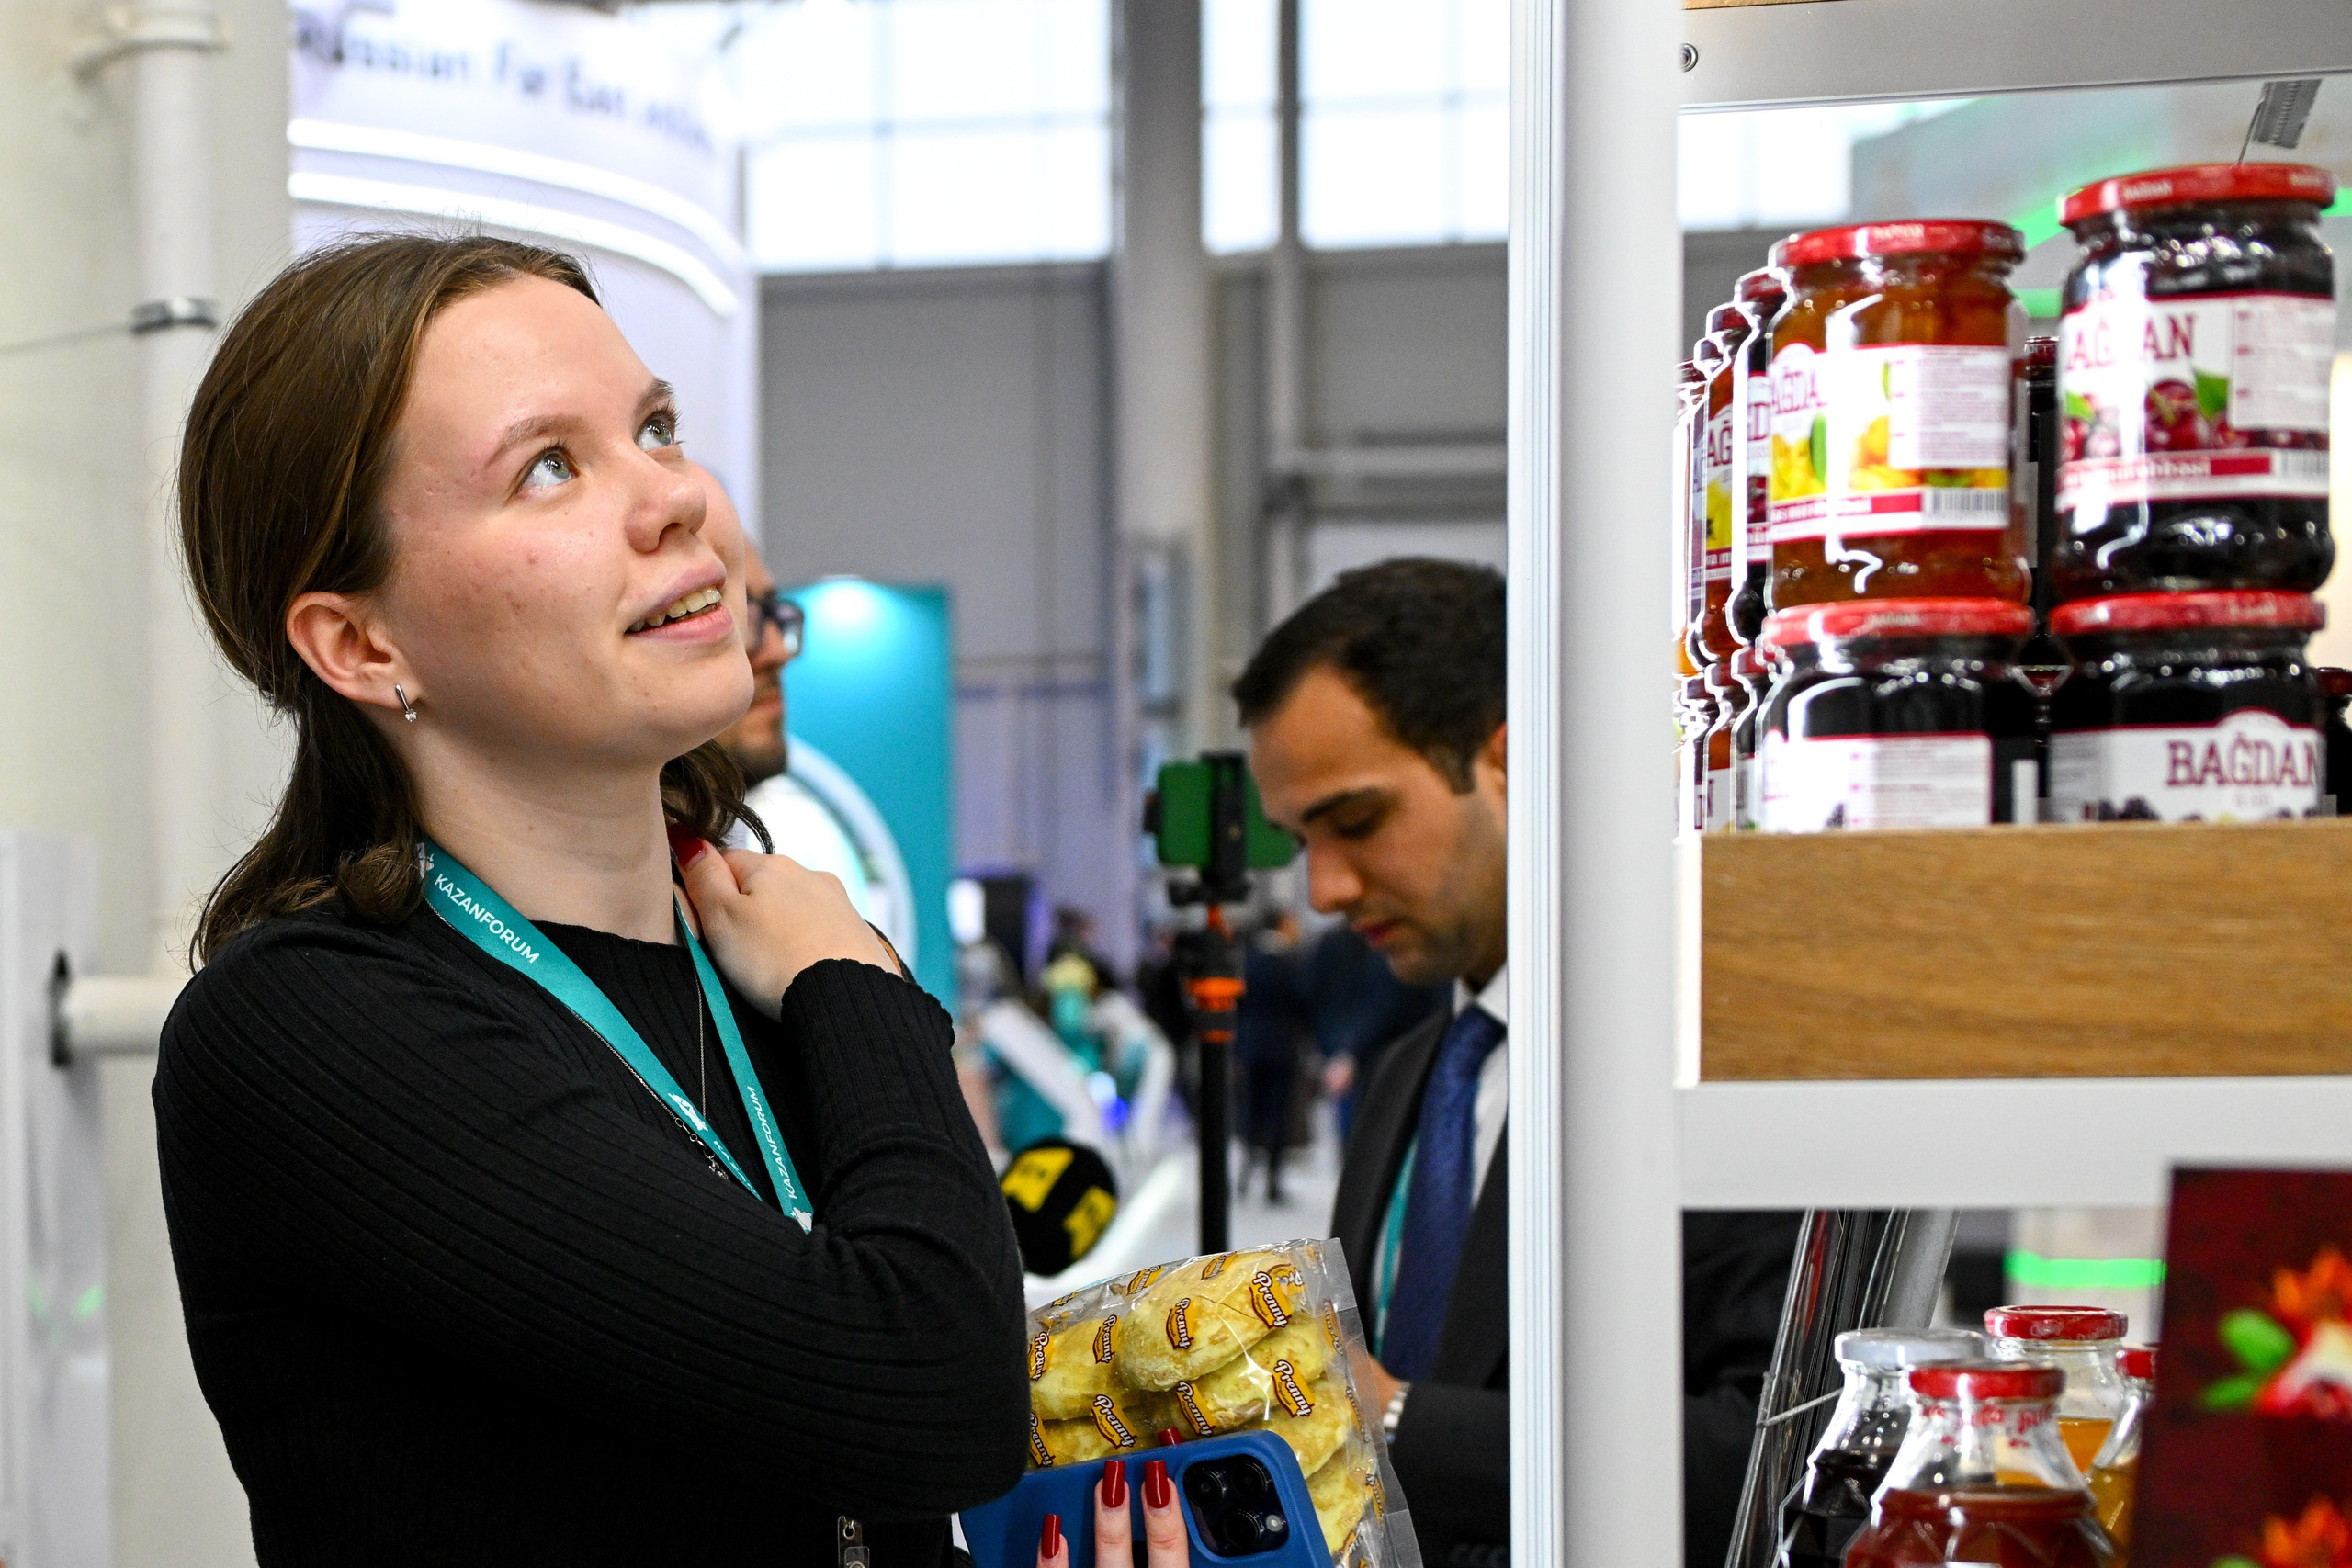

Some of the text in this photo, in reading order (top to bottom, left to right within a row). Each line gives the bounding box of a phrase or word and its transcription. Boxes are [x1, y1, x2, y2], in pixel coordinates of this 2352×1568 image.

[434, 873, 540, 964] KAZANFORUM
[746, 1085, 798, 1200] KAZANFORUM
[1175, 1297, 1192, 1349] Prenny
[1252, 1271, 1288, 1328] Prenny
[1102, 1314, 1118, 1364] Prenny
[1177, 1381, 1214, 1437] Prenny
[1273, 1359, 1312, 1417] Prenny
[1093, 1393, 1136, 1448] Prenny
